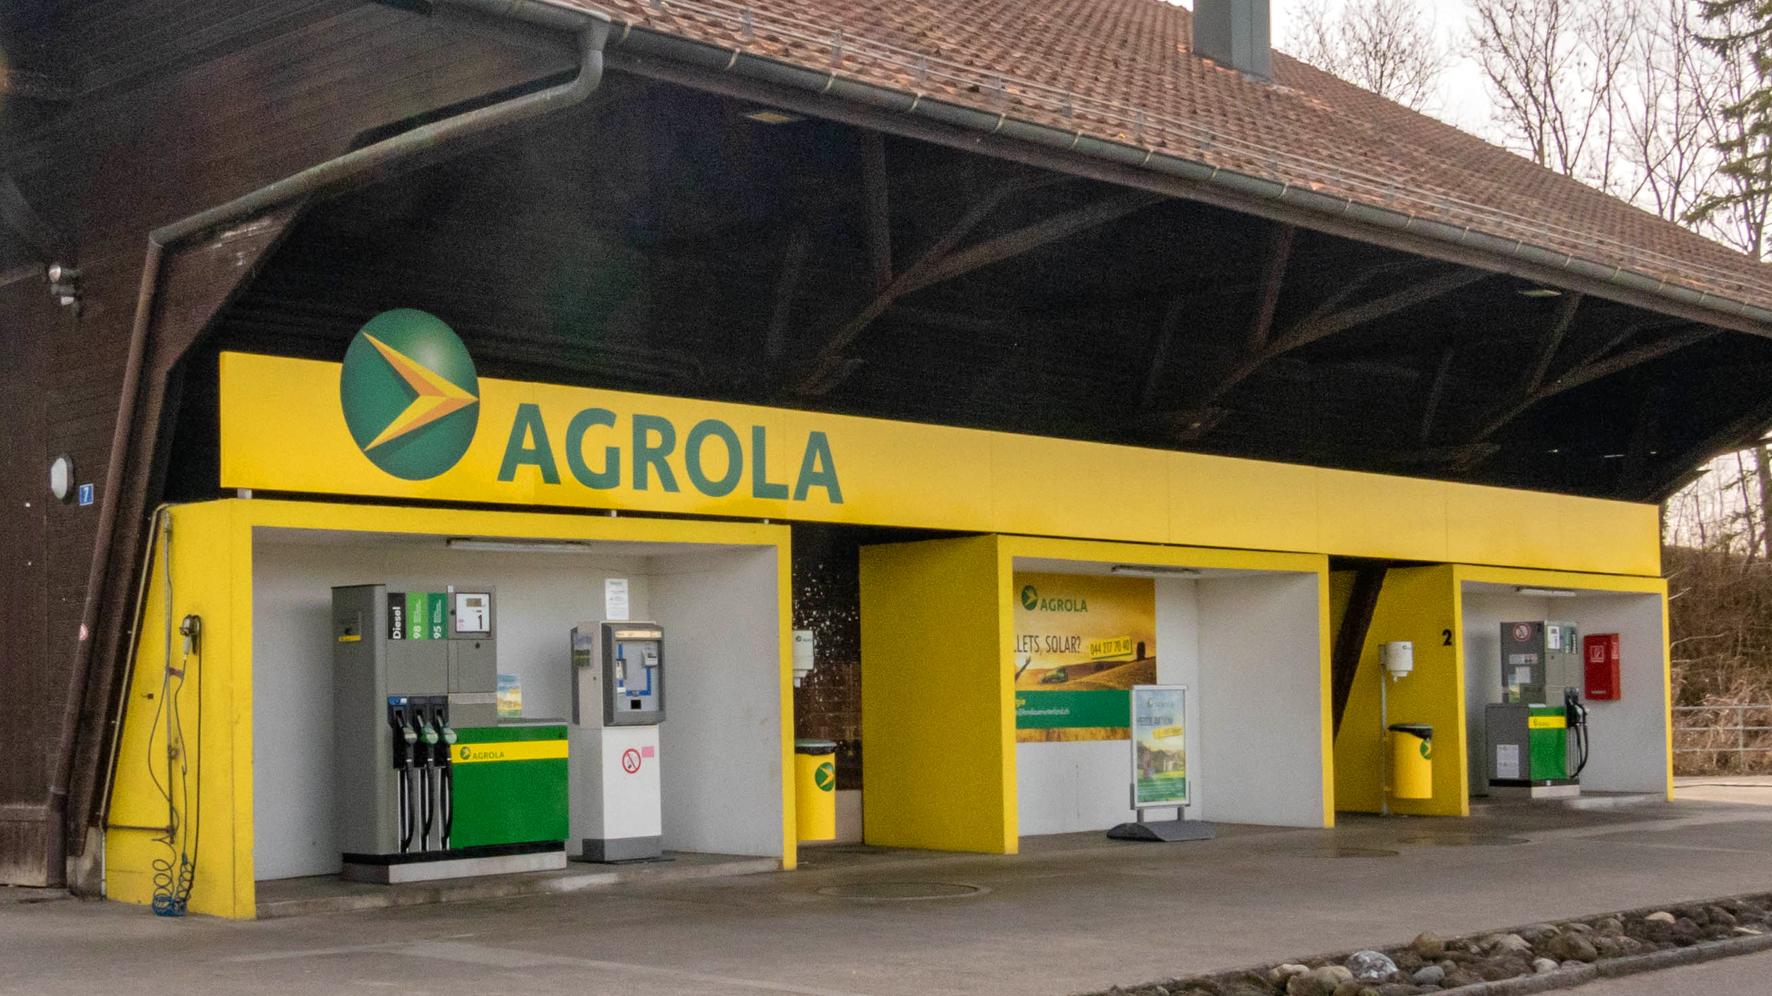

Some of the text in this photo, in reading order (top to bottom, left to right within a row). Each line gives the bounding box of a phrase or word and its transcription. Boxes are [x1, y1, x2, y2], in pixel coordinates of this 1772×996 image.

[496, 402, 844, 504] AGROLA
[1040, 598, 1089, 613] AGROLA
[392, 606, 402, 639] Diesel
[478, 614, 483, 630] 1
[413, 625, 422, 639] 98
[433, 625, 442, 639] 95
[1442, 629, 1452, 646] 2
[1014, 634, 1081, 656] LETS, SOLAR?
[472, 751, 505, 759] AGROLA
